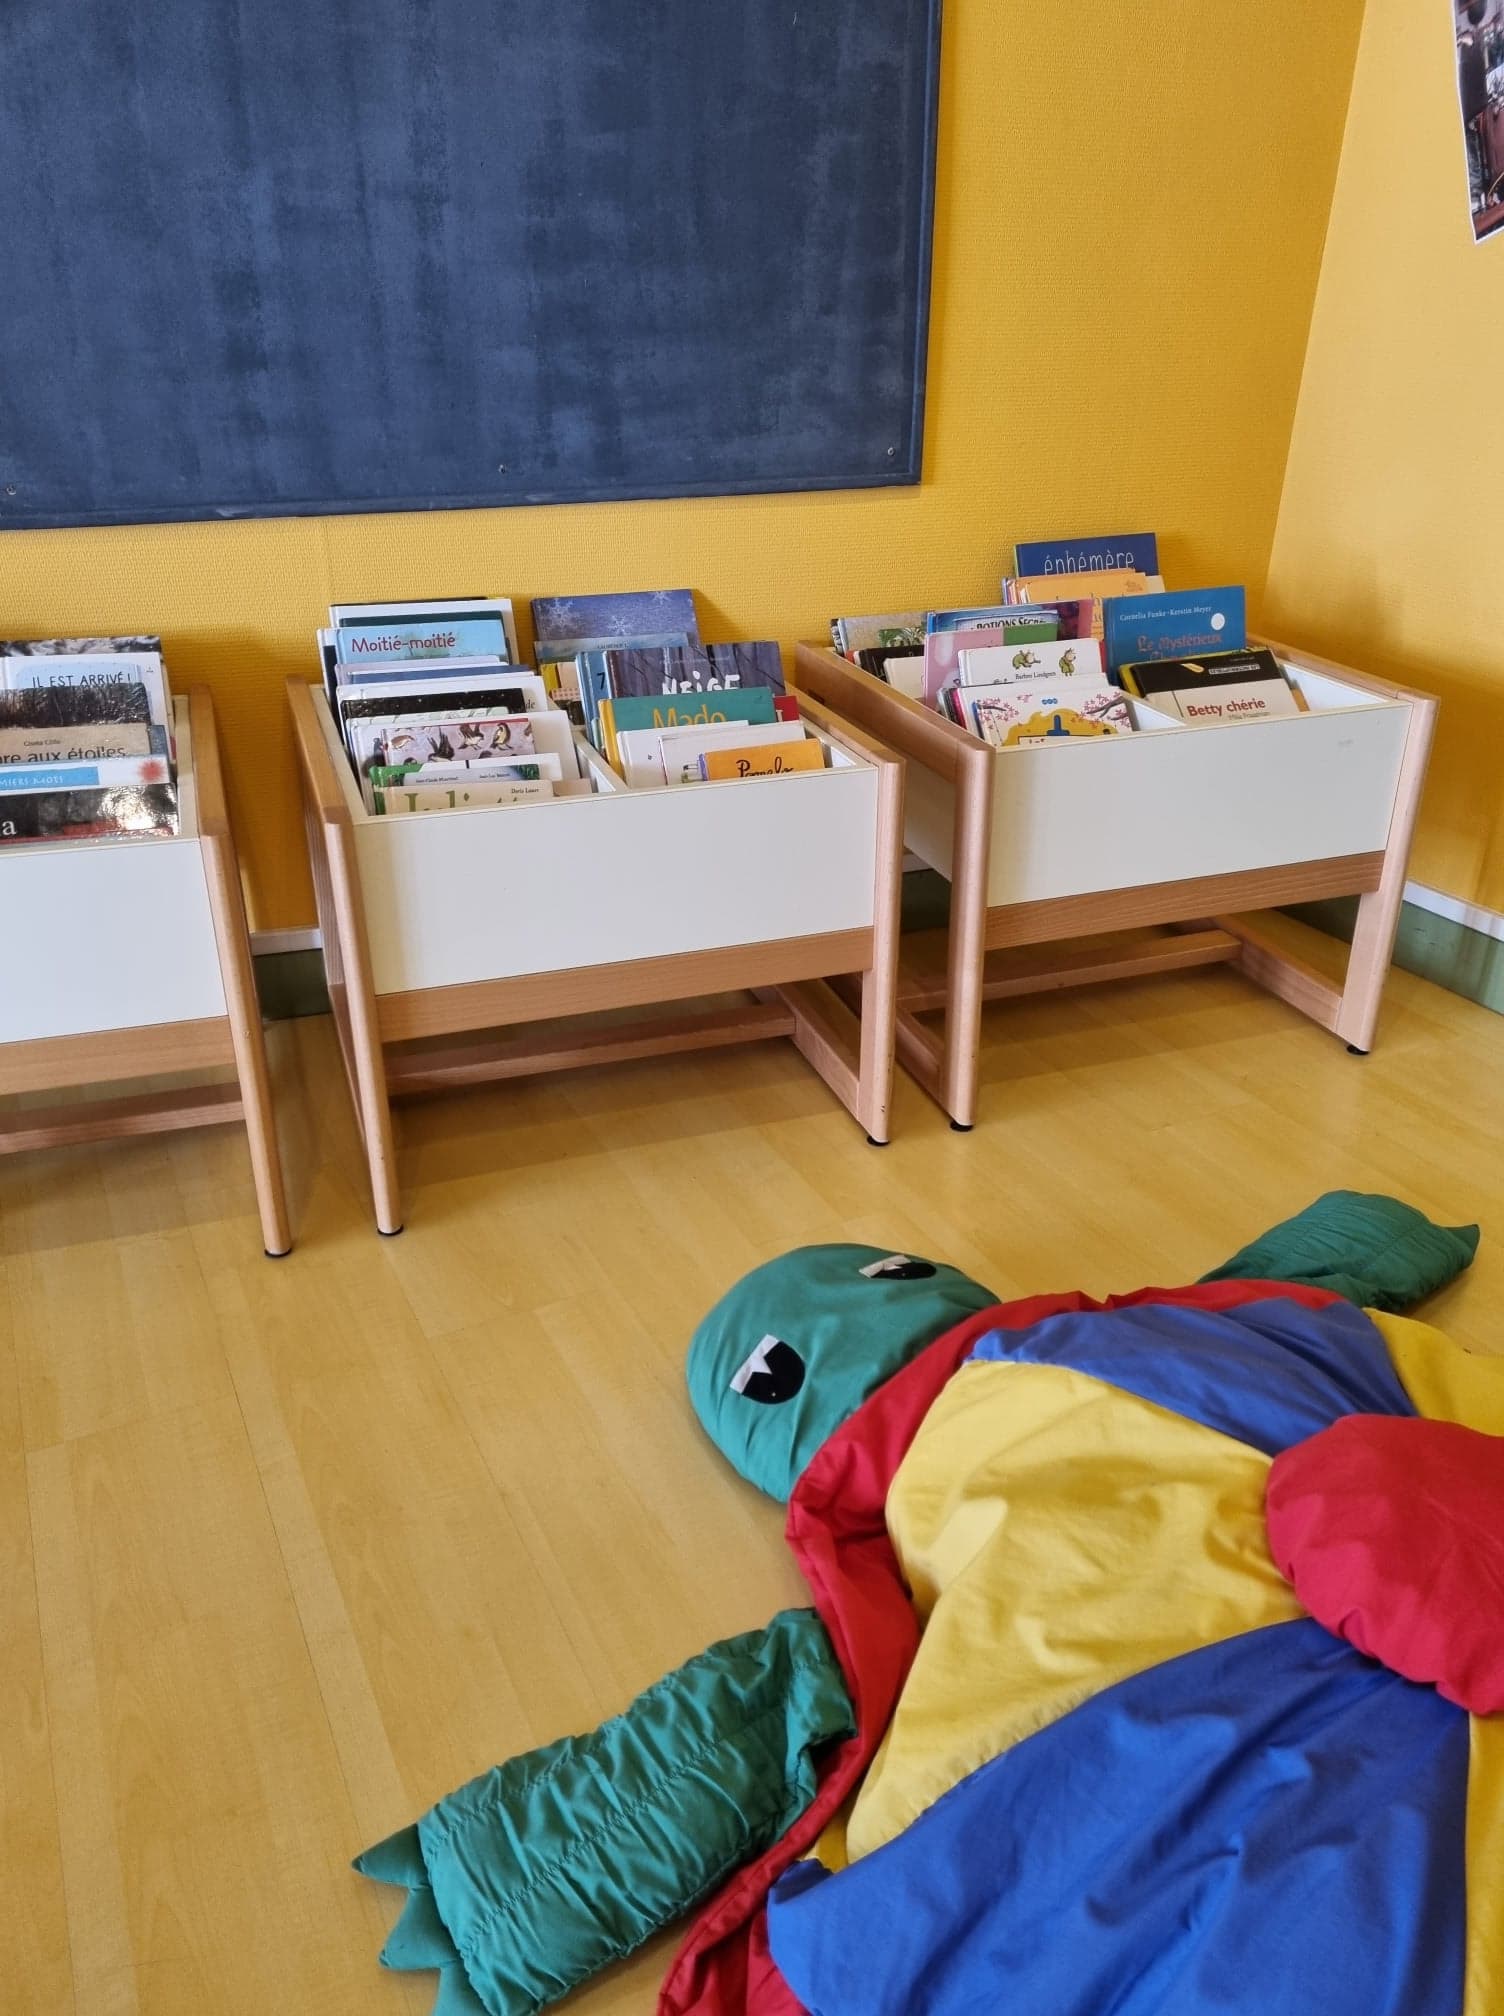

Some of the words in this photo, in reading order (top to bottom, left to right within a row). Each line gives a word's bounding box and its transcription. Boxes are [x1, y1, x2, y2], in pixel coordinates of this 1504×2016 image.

[352, 632, 455, 653] Moitié-moitié
[49, 674, 74, 687] EST
[80, 671, 124, 686] ARRIVÉ
[1187, 704, 1222, 717] Betty
[1226, 697, 1266, 713] chérie
[28, 750, 61, 763] aux
[67, 745, 126, 760] étoiles
